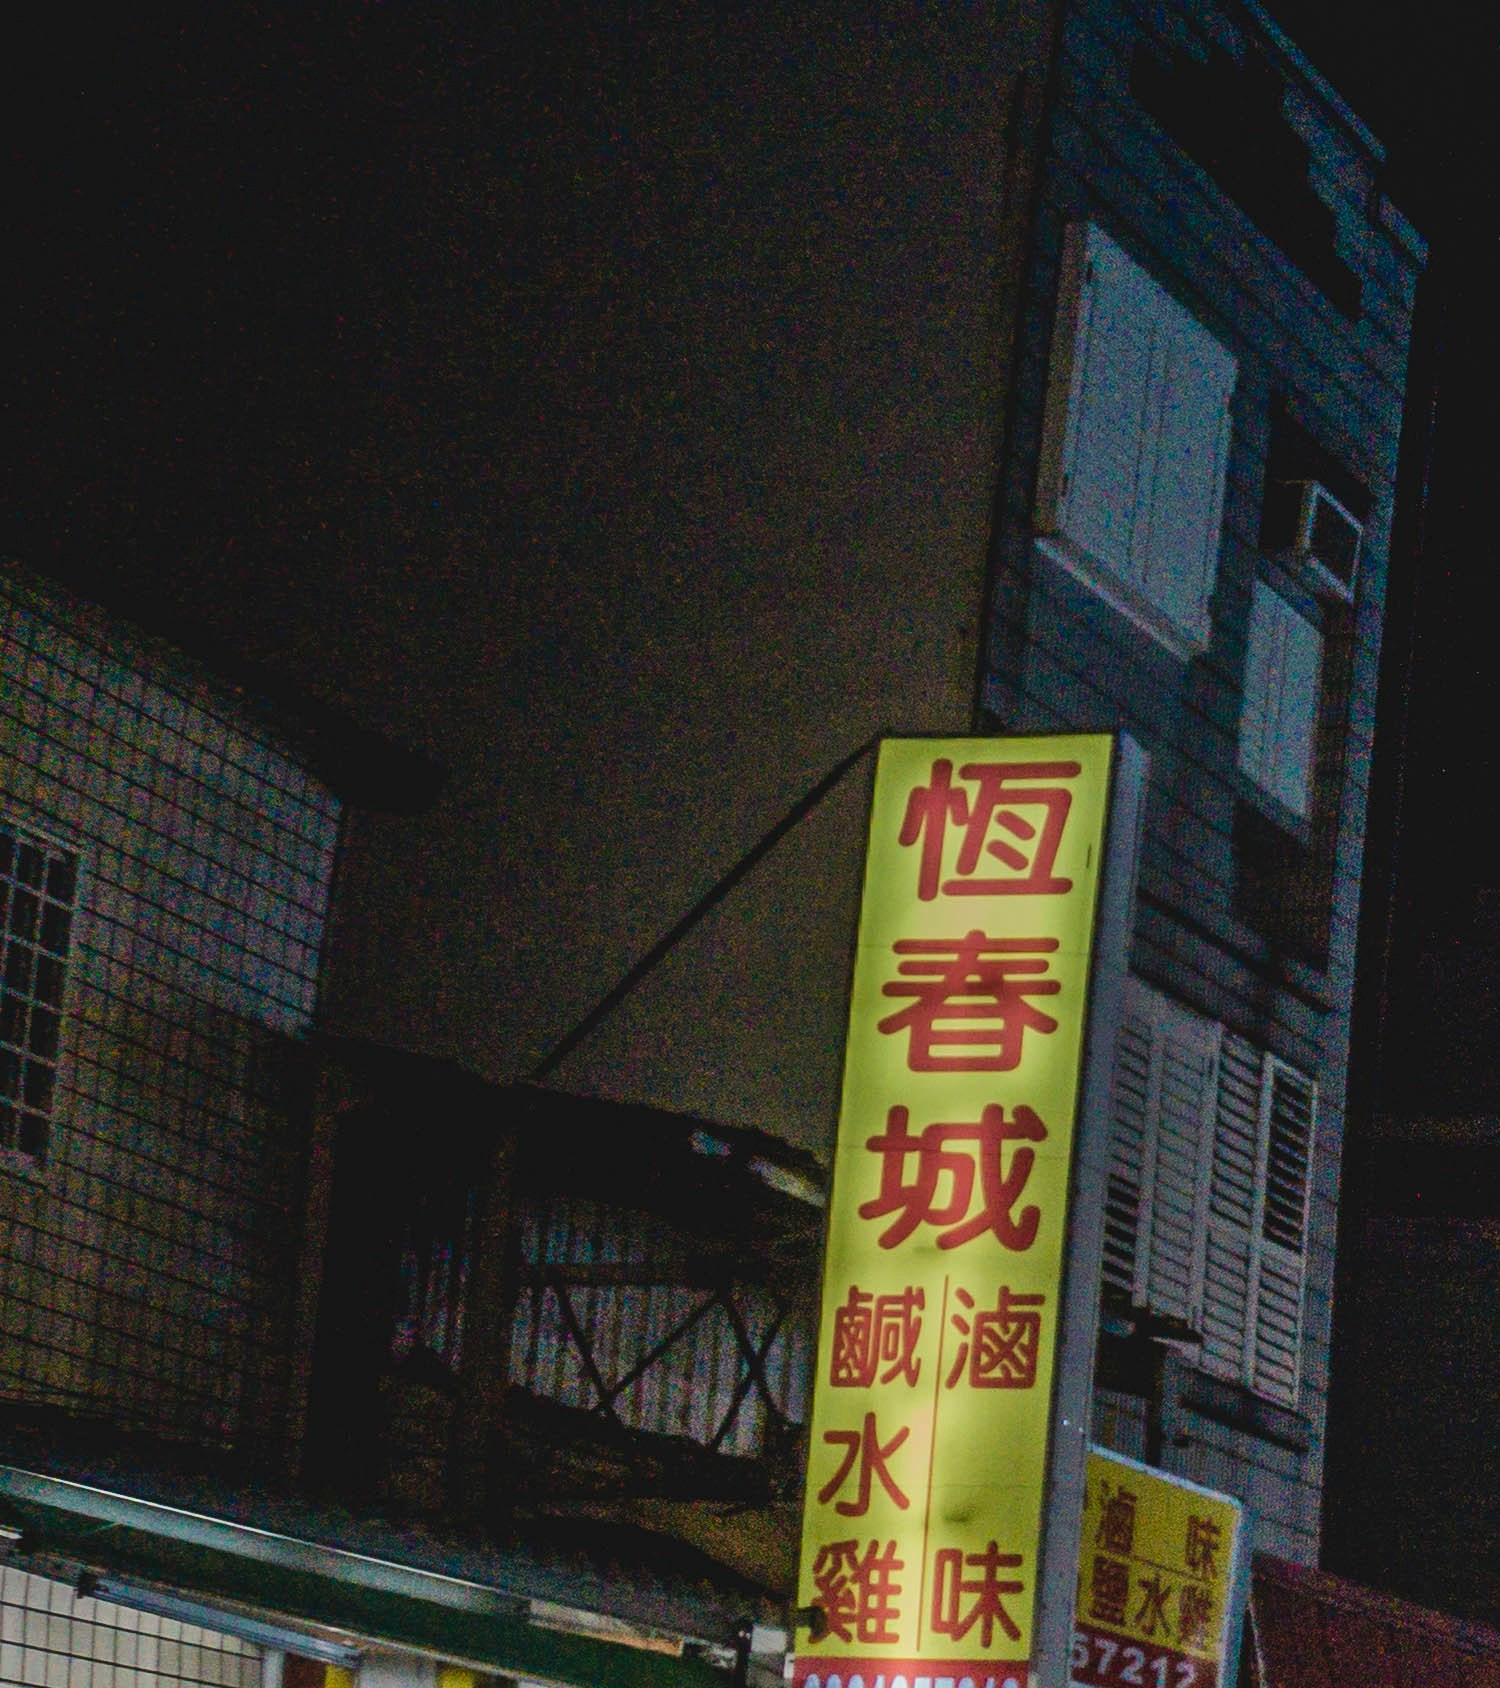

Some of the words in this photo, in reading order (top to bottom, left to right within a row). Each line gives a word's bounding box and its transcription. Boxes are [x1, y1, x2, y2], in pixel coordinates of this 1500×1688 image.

[858, 757, 1083, 1253] 恆春城
[930, 1284, 1047, 1650] 滷味
